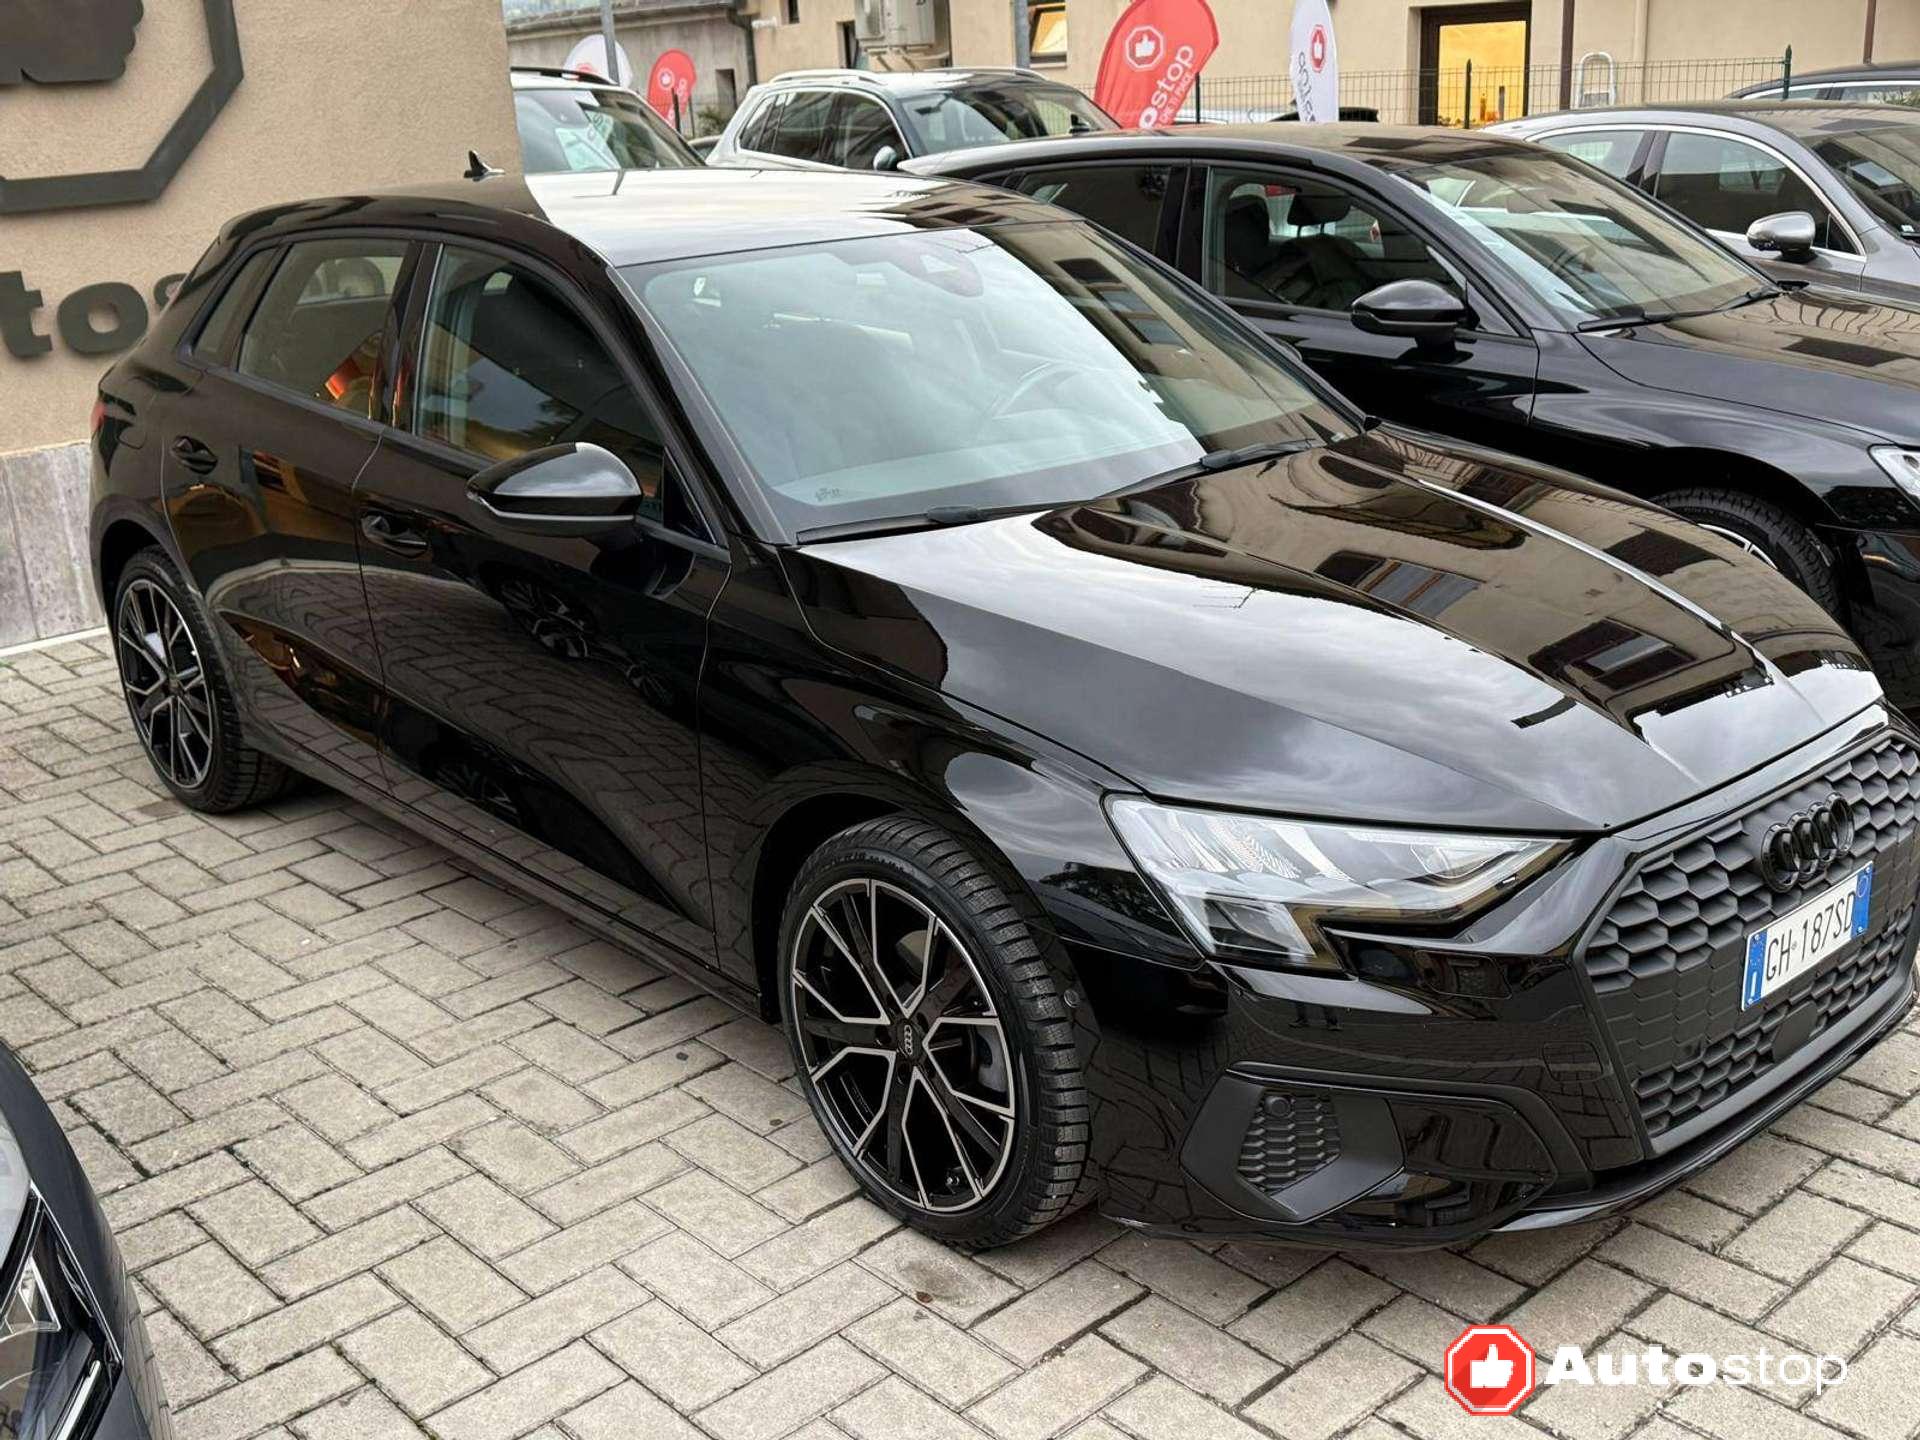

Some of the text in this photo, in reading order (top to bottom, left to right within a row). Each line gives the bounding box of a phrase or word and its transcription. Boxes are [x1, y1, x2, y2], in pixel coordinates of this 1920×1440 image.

[0, 270, 188, 358] to
[1766, 891, 1856, 982] GH 187SD
